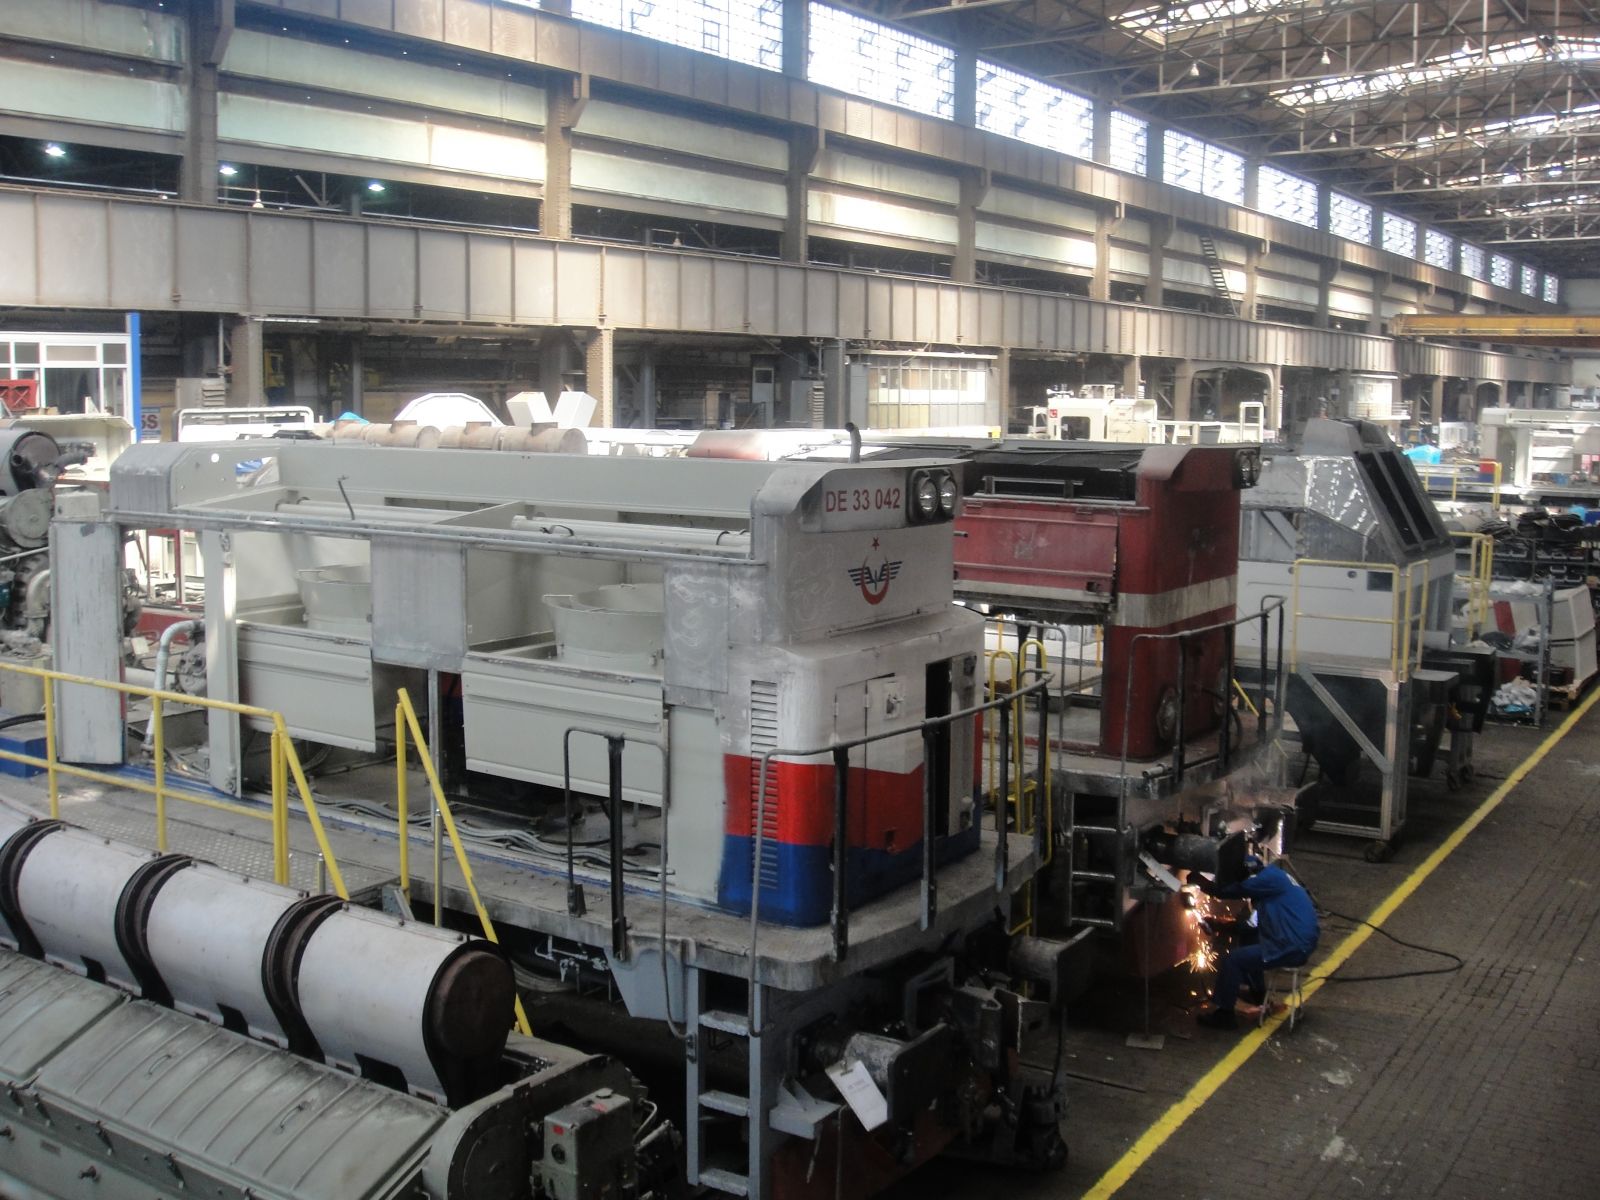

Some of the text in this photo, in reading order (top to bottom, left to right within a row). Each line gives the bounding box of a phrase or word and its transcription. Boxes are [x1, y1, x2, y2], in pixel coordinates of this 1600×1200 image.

[826, 487, 901, 512] DE 33 042
